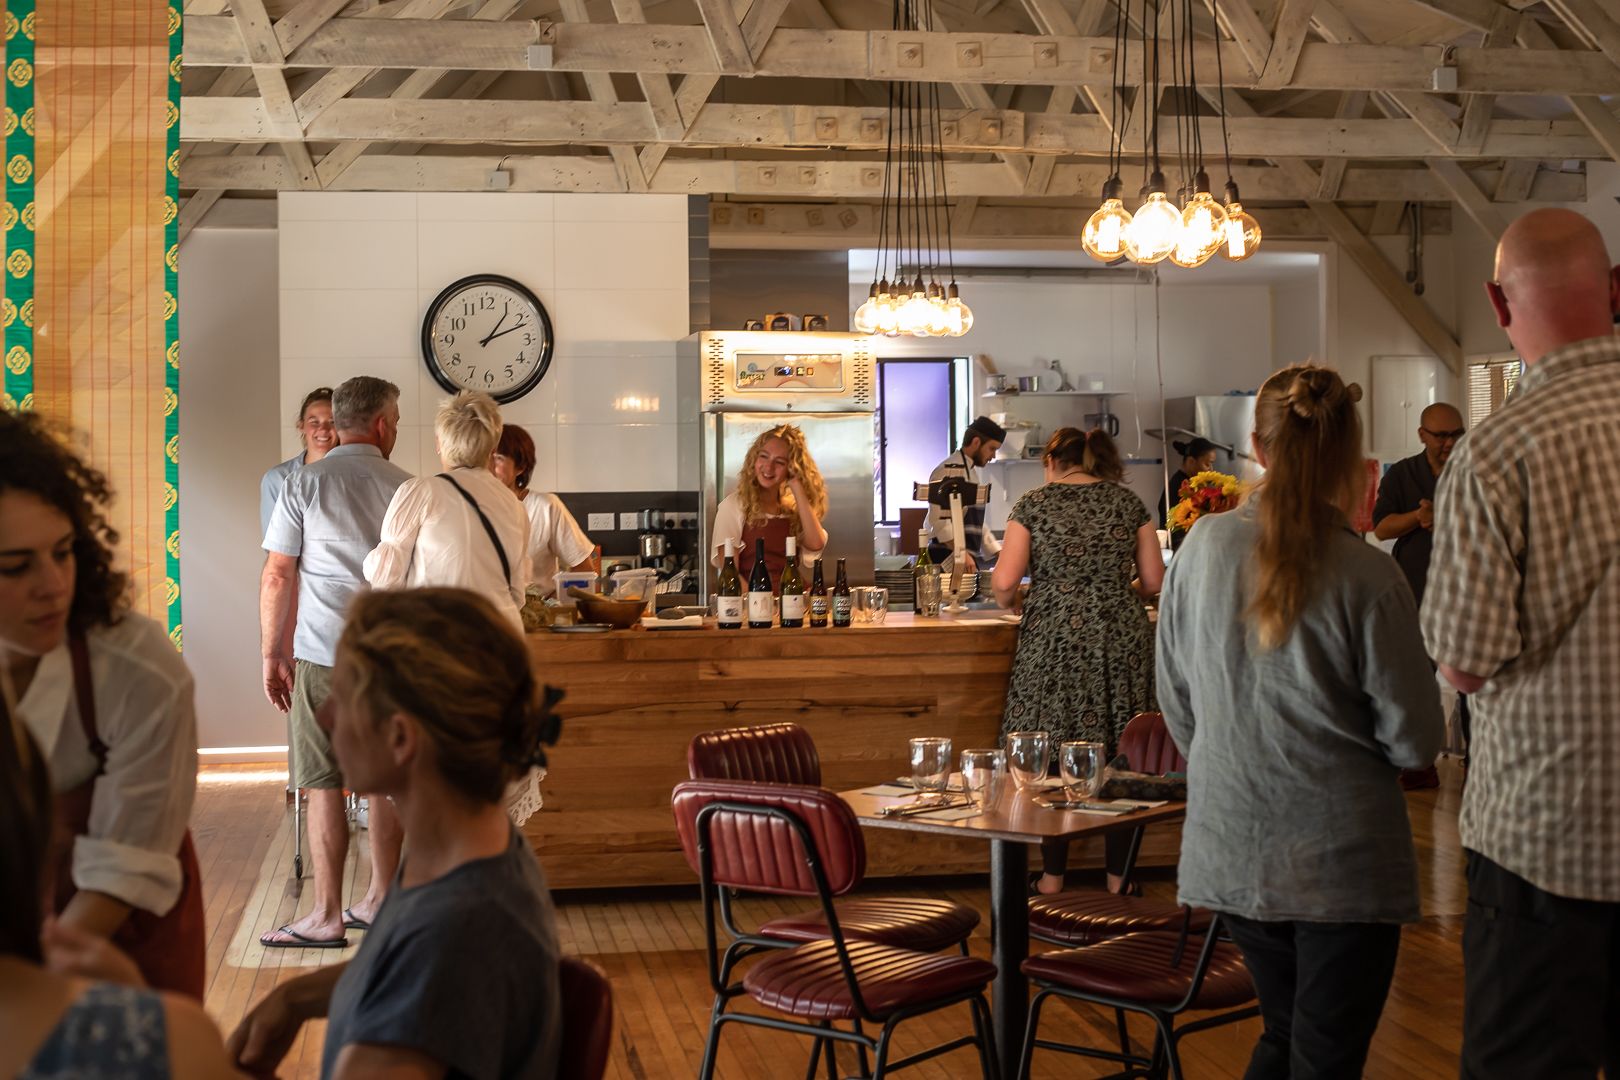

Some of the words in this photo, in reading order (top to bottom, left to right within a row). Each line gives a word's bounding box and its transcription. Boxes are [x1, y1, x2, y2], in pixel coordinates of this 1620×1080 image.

[464, 303, 475, 316] 11
[480, 297, 495, 310] 12
[451, 318, 466, 331] 10
[513, 313, 525, 327] 2
[444, 334, 455, 347] 9
[523, 333, 532, 346] 3
[451, 353, 461, 366] 8
[515, 351, 525, 364] 4
[467, 365, 476, 378] 7
[484, 369, 494, 384] 6
[504, 364, 513, 378] 5
